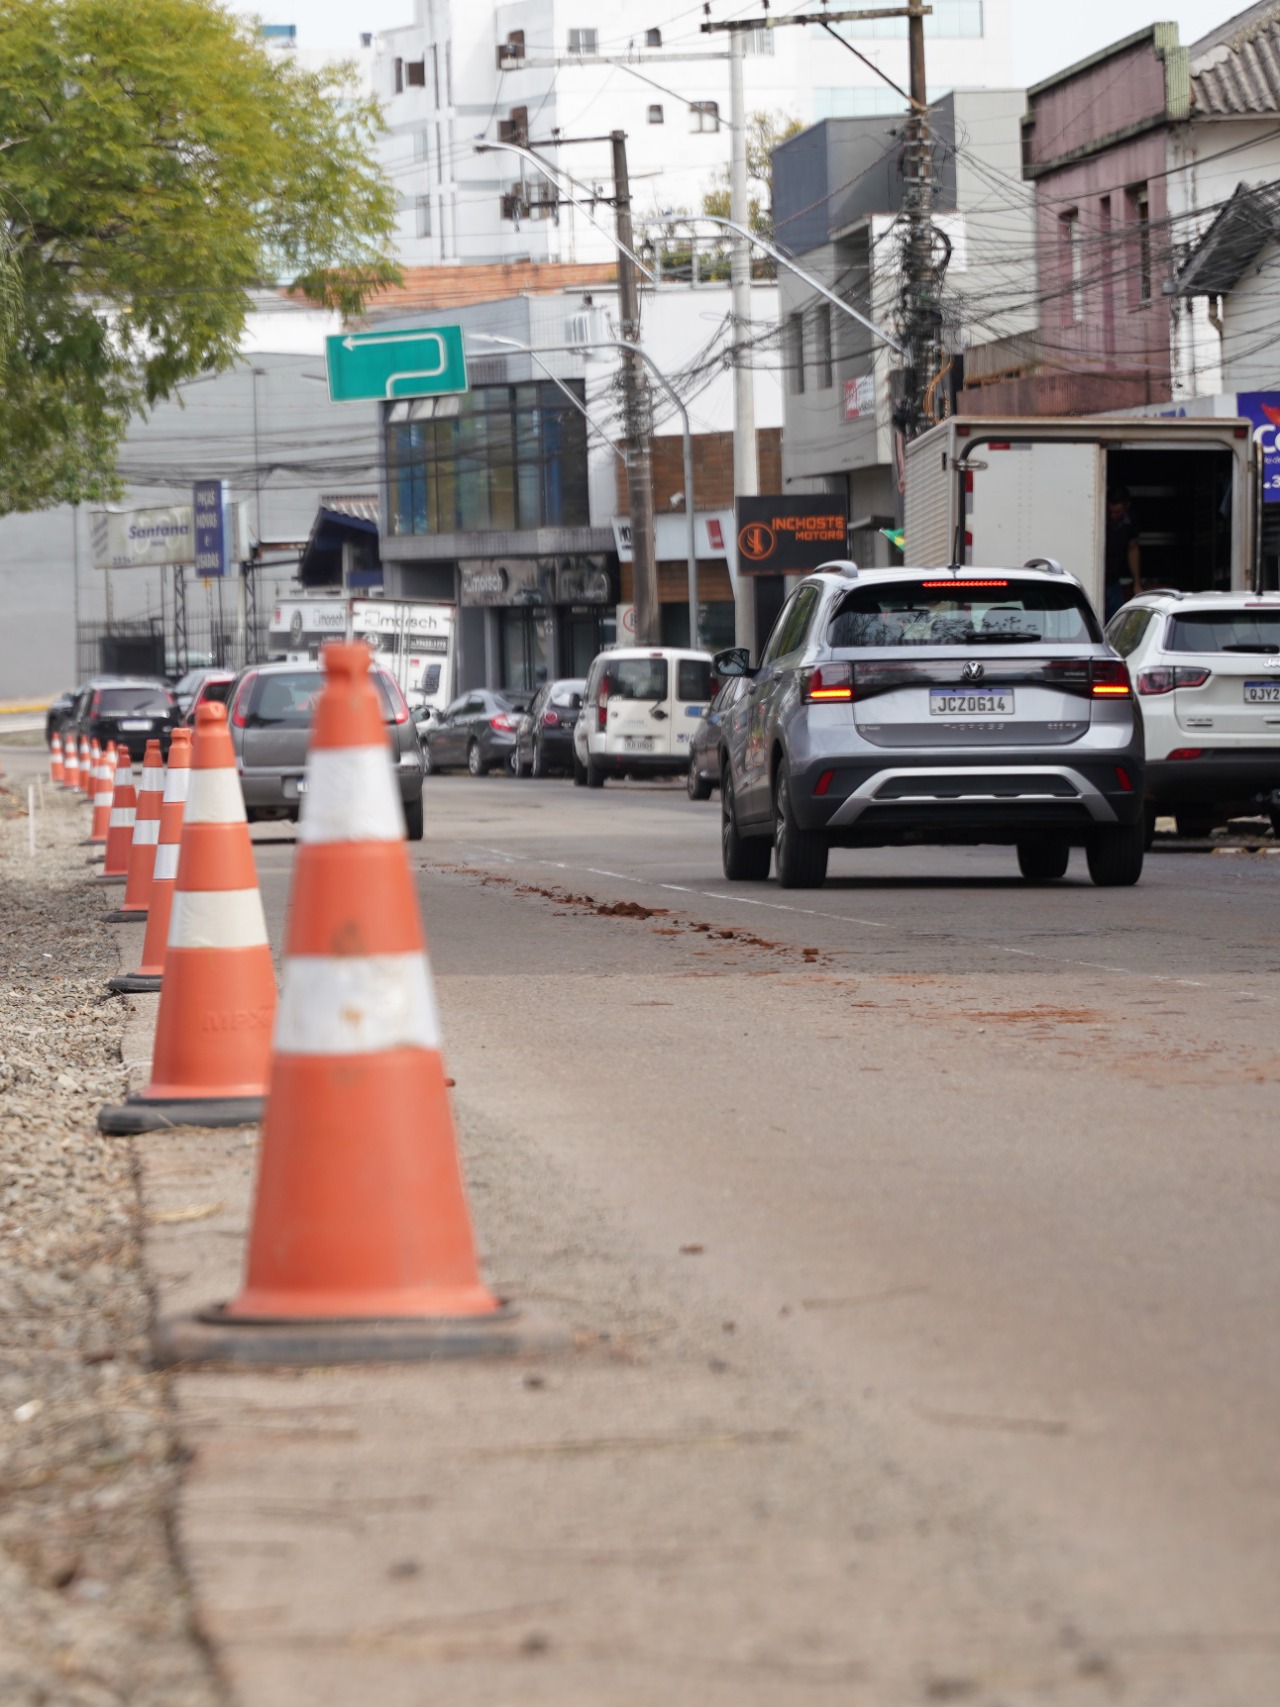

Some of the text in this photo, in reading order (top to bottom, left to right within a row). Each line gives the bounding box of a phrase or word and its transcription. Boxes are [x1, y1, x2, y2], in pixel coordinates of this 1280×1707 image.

[772, 516, 845, 530] INCHOSTE
[128, 524, 189, 539] Santana
[795, 531, 845, 541] MOTORS
[938, 696, 1006, 712] JCZ0G14
